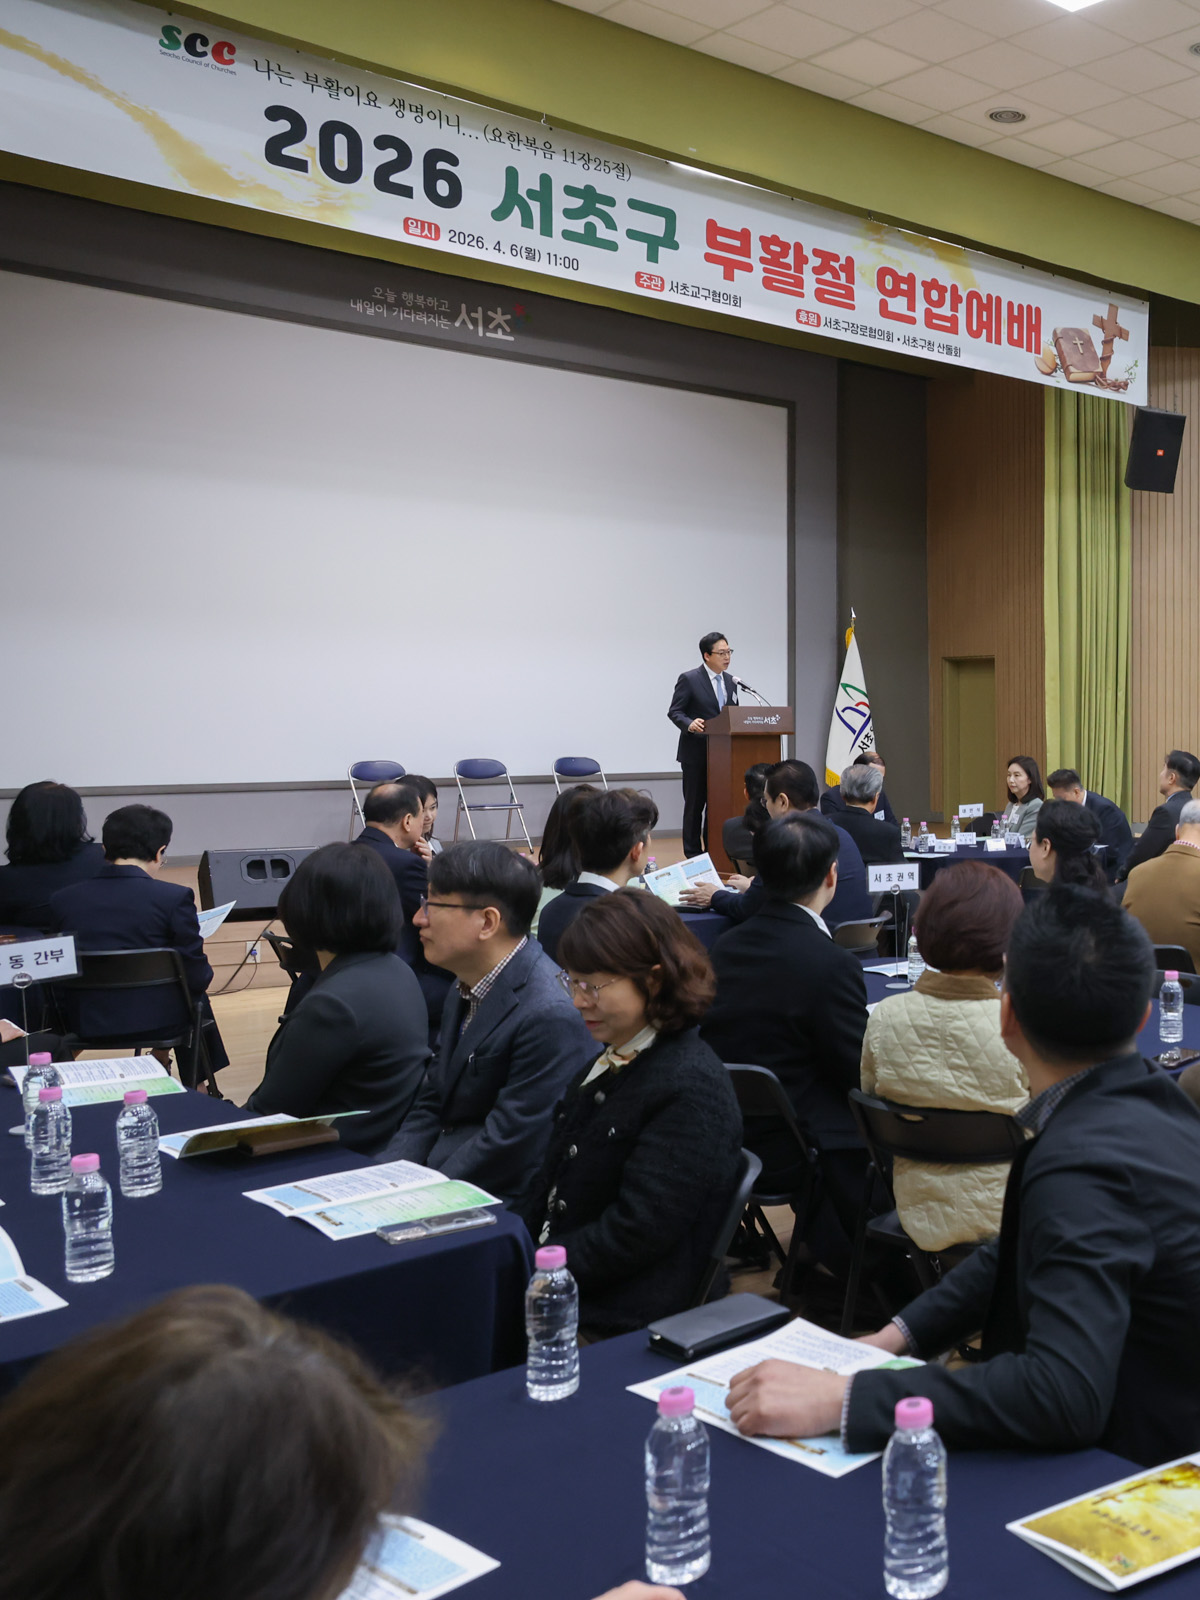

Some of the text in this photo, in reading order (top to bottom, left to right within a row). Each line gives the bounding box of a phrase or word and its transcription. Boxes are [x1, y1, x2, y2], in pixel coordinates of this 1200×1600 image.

[182, 55, 203, 66] Council
[211, 64, 237, 76] Churches
[253, 59, 295, 87] 나는
[302, 72, 382, 109] 부활이요
[484, 124, 556, 161] (요한복음
[562, 148, 632, 182] 11장25절)
[264, 105, 1043, 356] 2026 서초구 부활절 연합예배
[408, 218, 580, 271] 일시 2026. 4. 6(월) 11:00
[372, 286, 451, 312] 오늘 행복하고
[639, 272, 742, 308] 주관 서초교구협의회
[350, 298, 452, 330] 내일이 기다려지는
[454, 303, 515, 341] 서초
[798, 310, 818, 326] 후원
[901, 334, 935, 352] 서초구청
[763, 716, 777, 725] 서초
[33, 948, 64, 965] 간부
